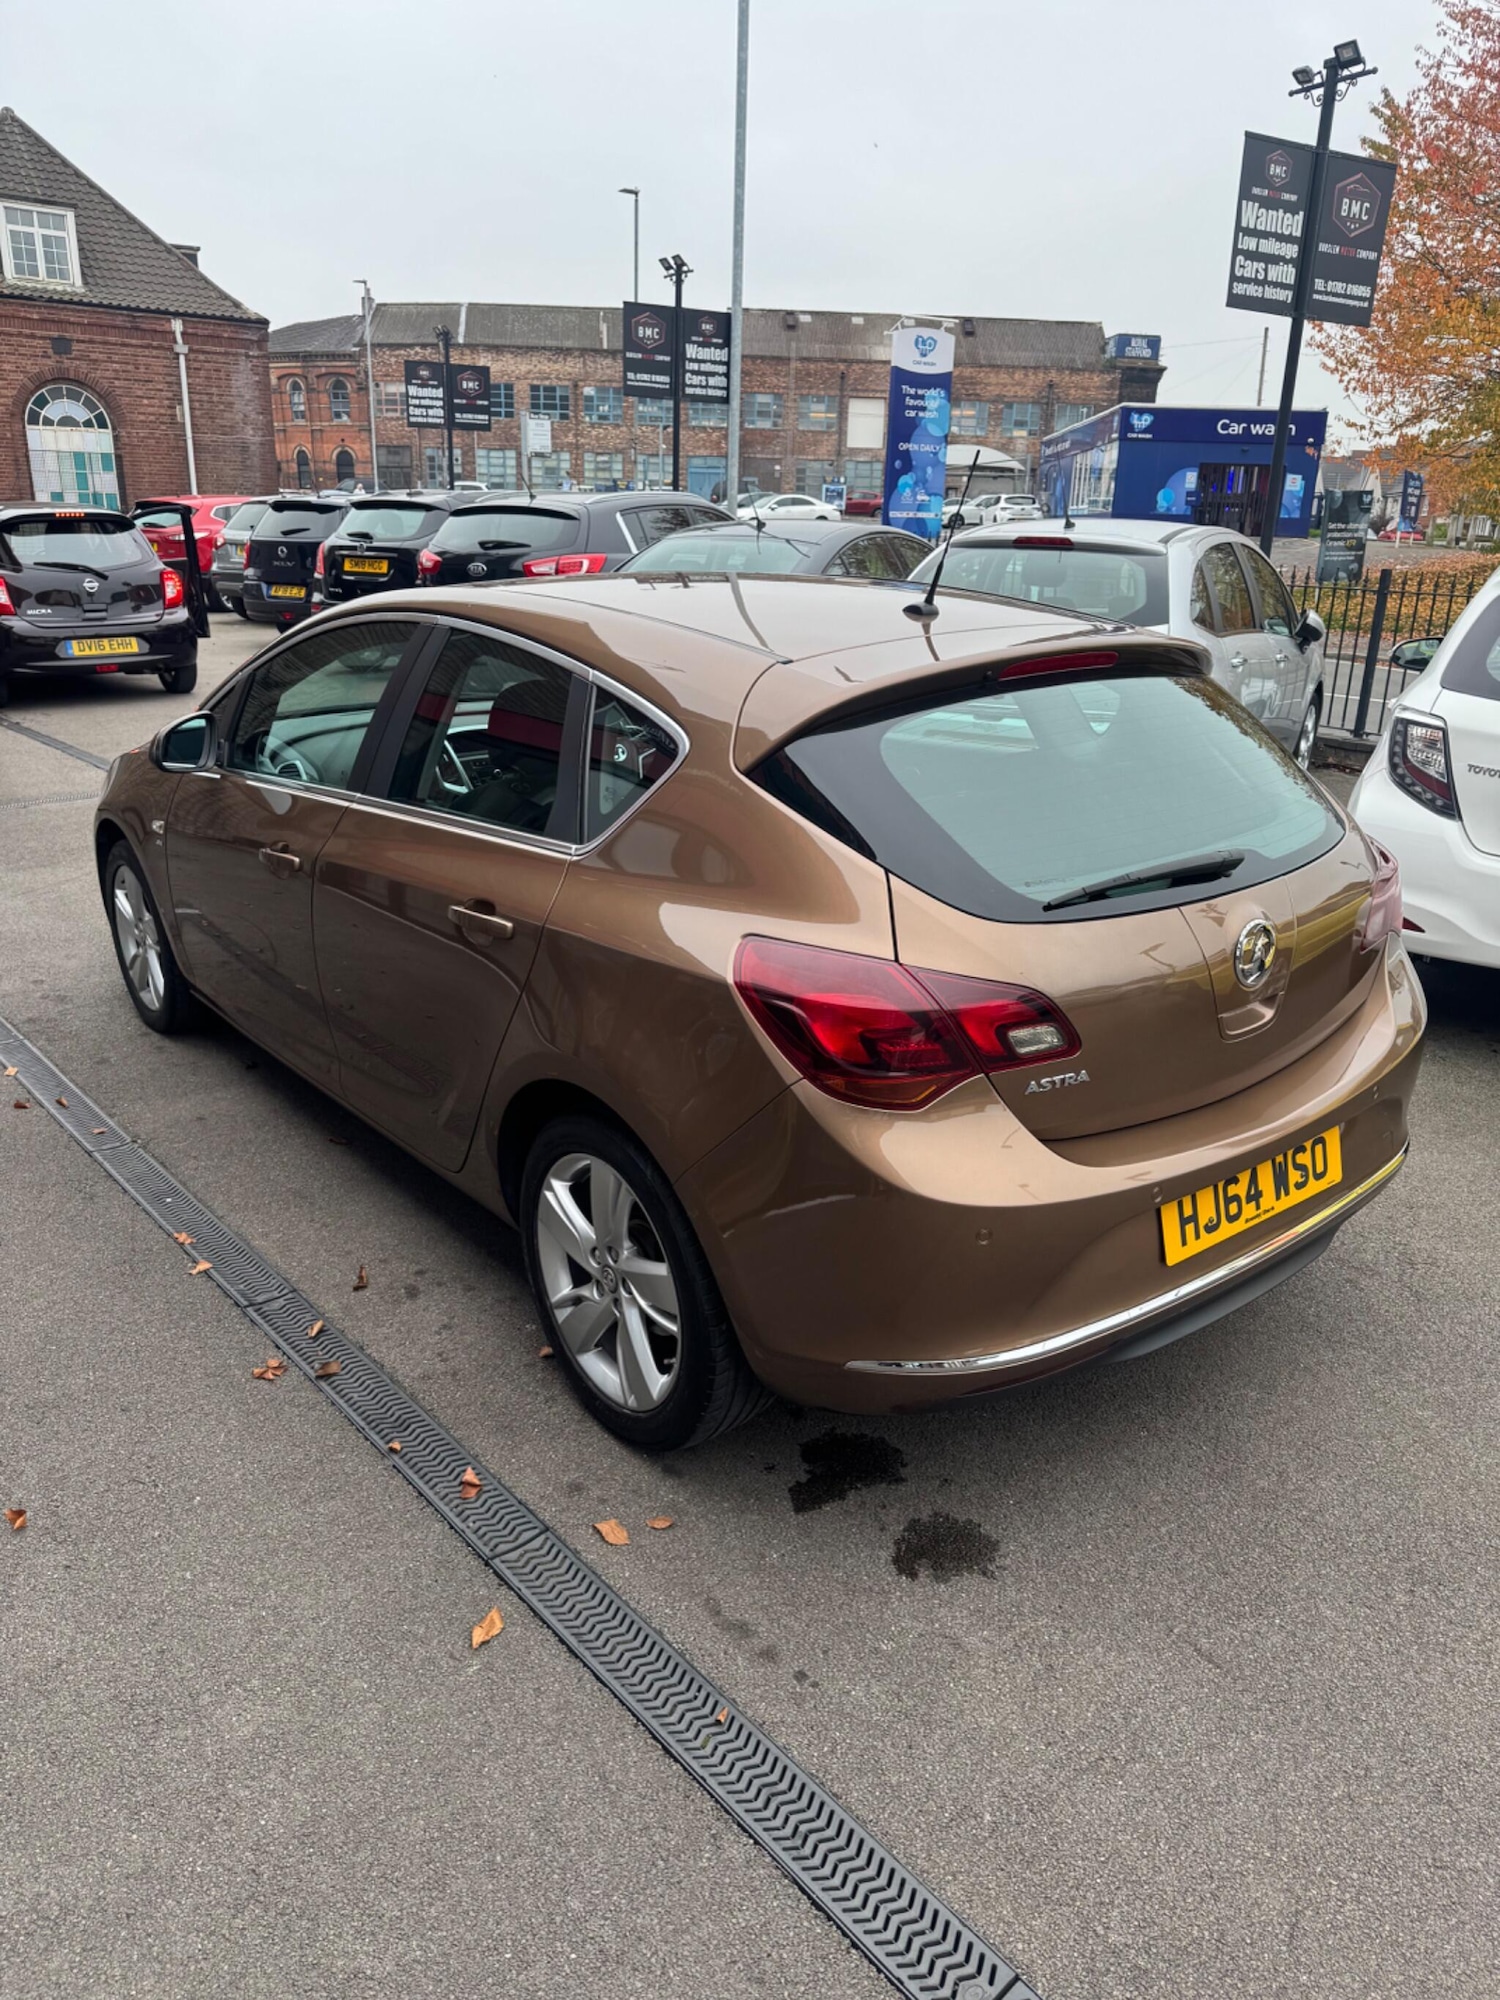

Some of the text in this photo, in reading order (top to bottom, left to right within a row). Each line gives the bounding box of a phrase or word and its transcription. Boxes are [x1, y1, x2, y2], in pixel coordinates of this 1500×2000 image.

[1269, 163, 1287, 178] BMC
[1341, 197, 1370, 221] BMC
[1241, 200, 1304, 237] Wanted
[1237, 232, 1299, 259] Low mileage
[1234, 254, 1296, 285] Cars with
[1232, 281, 1293, 304] service history
[637, 326, 660, 339] BMC
[685, 343, 728, 362] Wanted
[685, 360, 727, 374] Low mileage
[462, 380, 480, 390] BMC
[685, 372, 706, 386] Cars
[707, 375, 727, 388] with
[407, 385, 443, 398] Wanted
[685, 386, 727, 397] service history
[901, 384, 946, 398] The world's
[409, 406, 426, 416] Cars
[904, 409, 939, 419] car wash
[1216, 418, 1248, 435] Car
[898, 442, 940, 452] OPEN DAILY
[77, 637, 134, 653] DV16 EHH
[1024, 1069, 1091, 1095] ASTRA
[1177, 1135, 1328, 1248] HJ64 WSO
